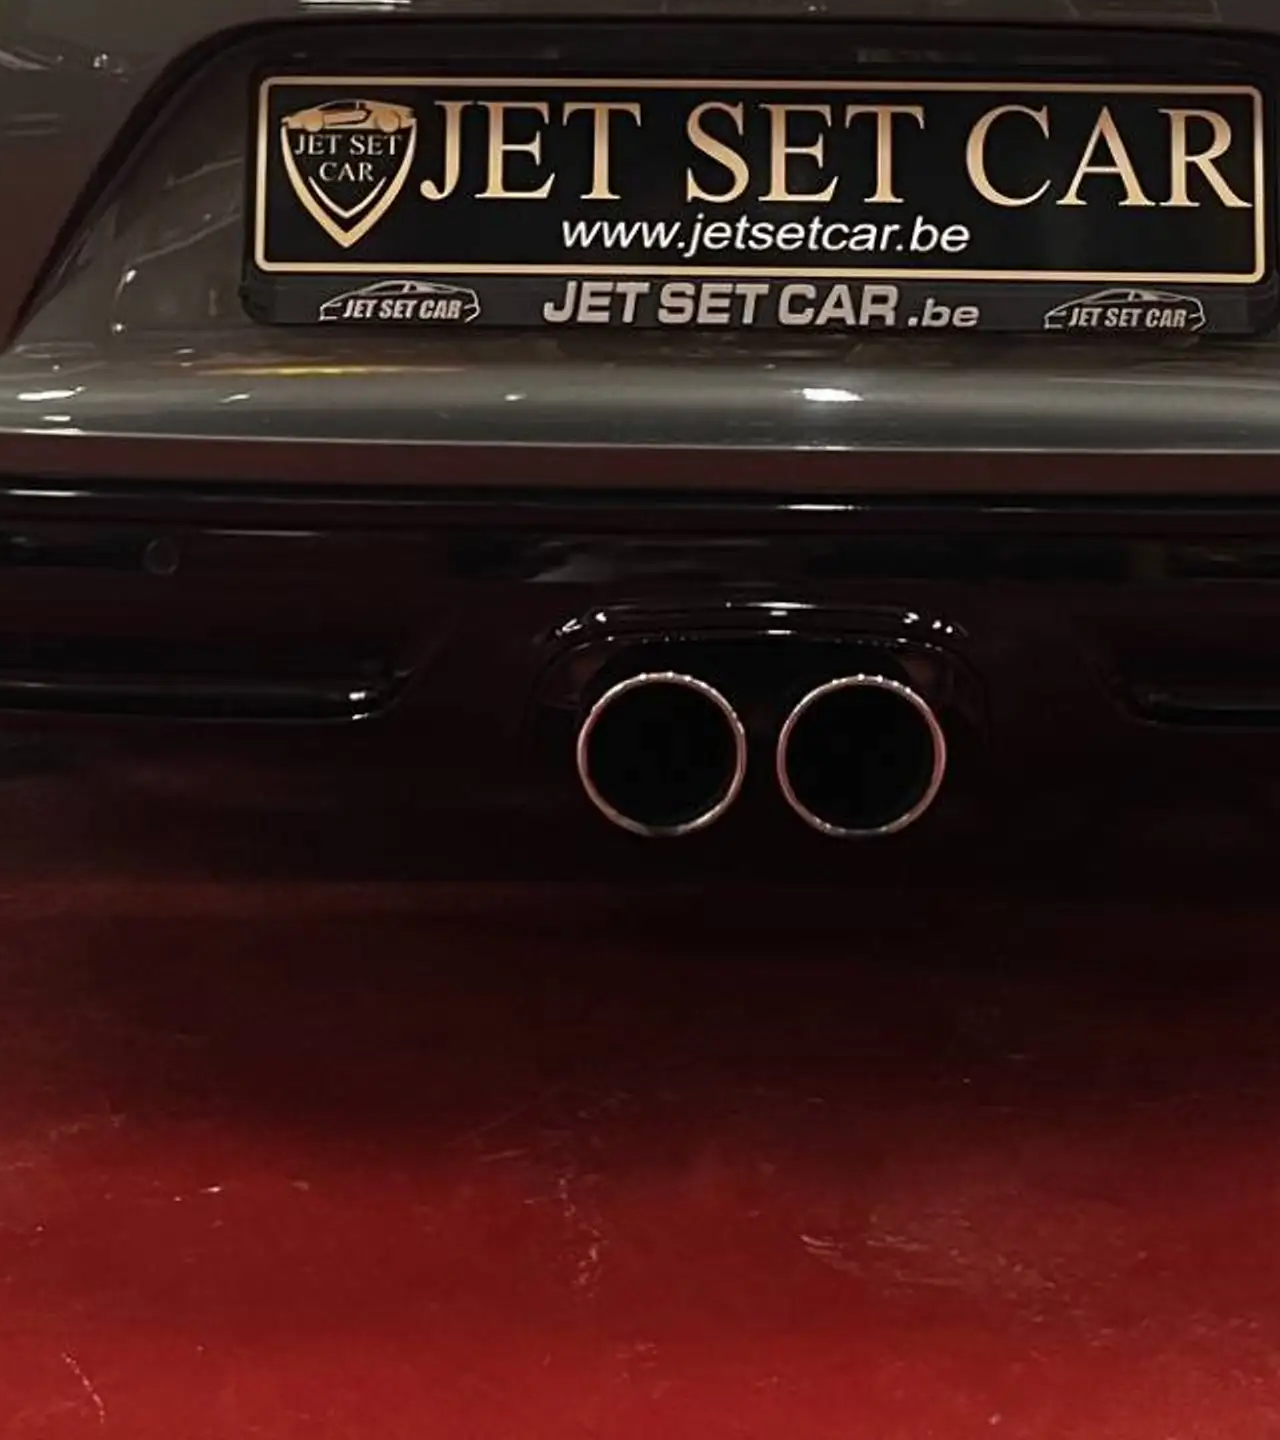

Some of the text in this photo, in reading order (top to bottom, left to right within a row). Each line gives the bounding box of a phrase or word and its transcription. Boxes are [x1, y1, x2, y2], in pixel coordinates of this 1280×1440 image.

[294, 133, 402, 156] JET SET
[419, 99, 1253, 208] JET SET CAR
[319, 162, 374, 182] CAR
[562, 213, 970, 258] www.jetsetcar.be
[342, 298, 463, 320] JET SET CAR
[543, 280, 651, 324] JET
[658, 281, 770, 325] SET
[1068, 308, 1188, 329] JET SET CAR
